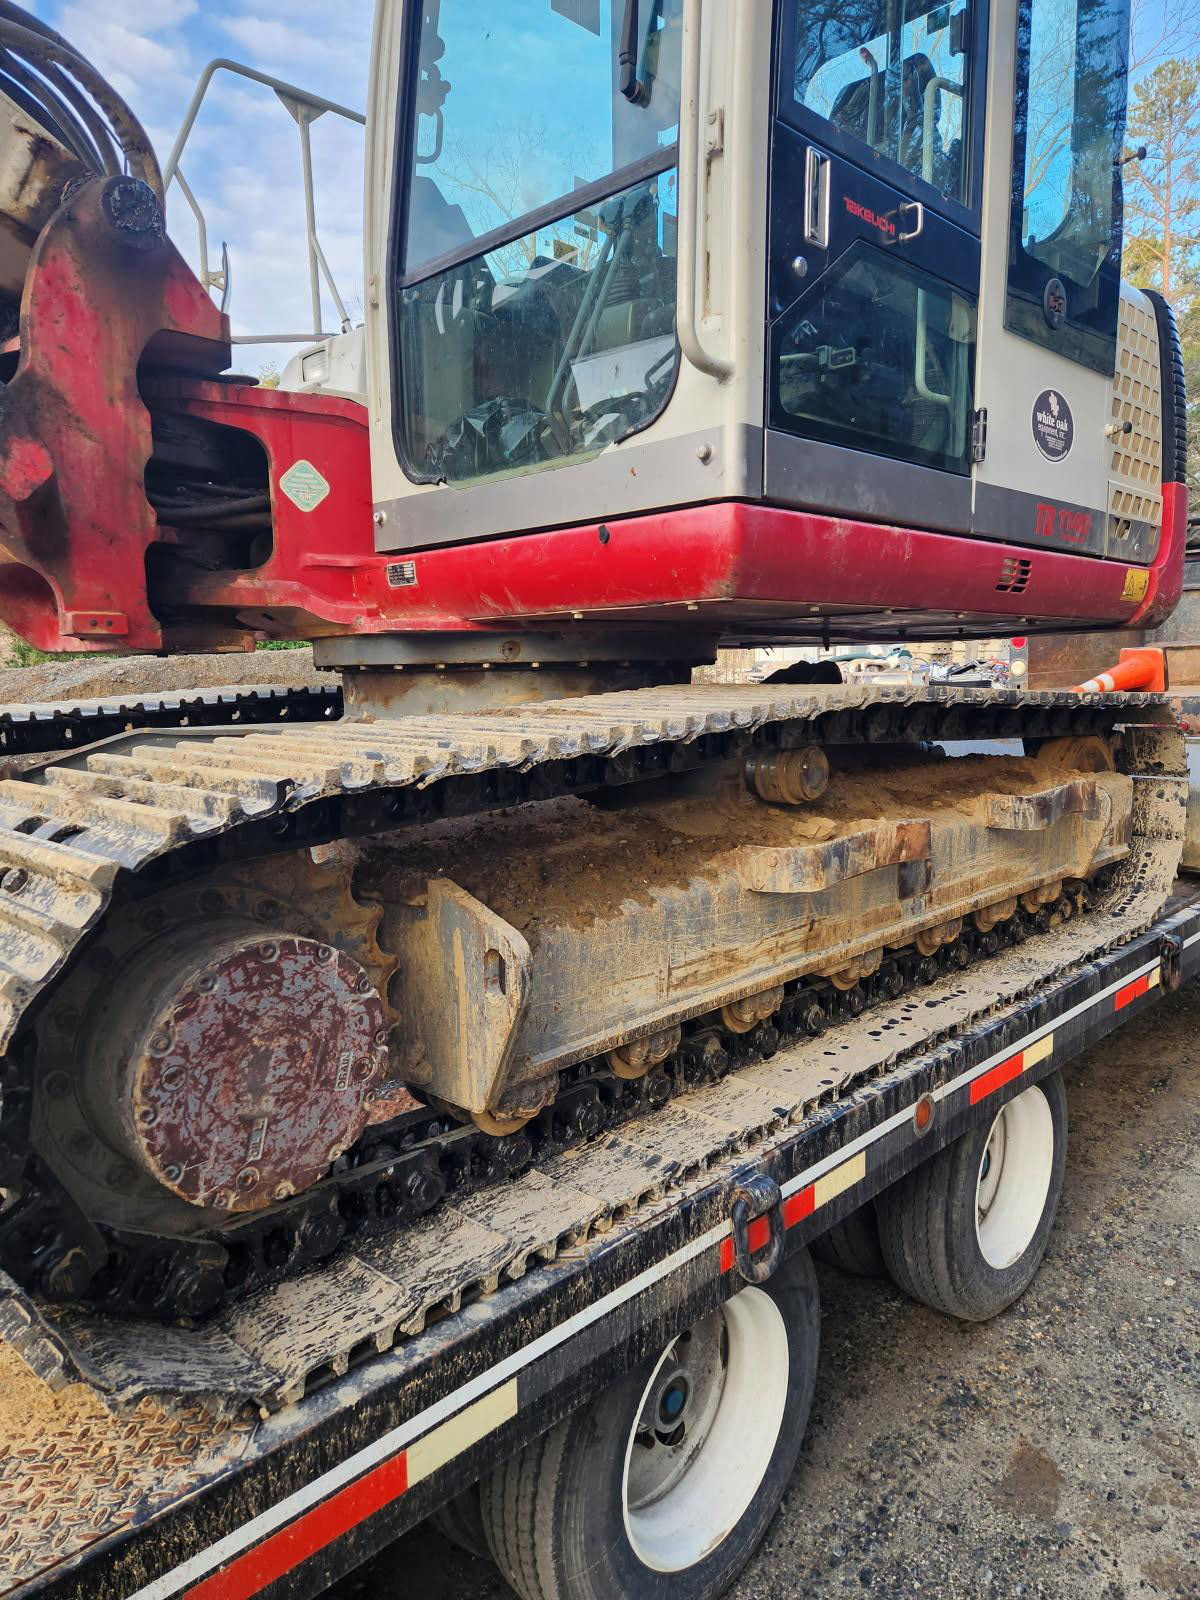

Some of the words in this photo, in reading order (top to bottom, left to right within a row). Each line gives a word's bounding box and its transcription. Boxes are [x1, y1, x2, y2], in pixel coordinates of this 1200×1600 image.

[843, 197, 895, 236] TAKEUCHI
[1036, 410, 1056, 427] white
[1056, 418, 1069, 432] oak
[335, 1051, 352, 1089] DRAIN
